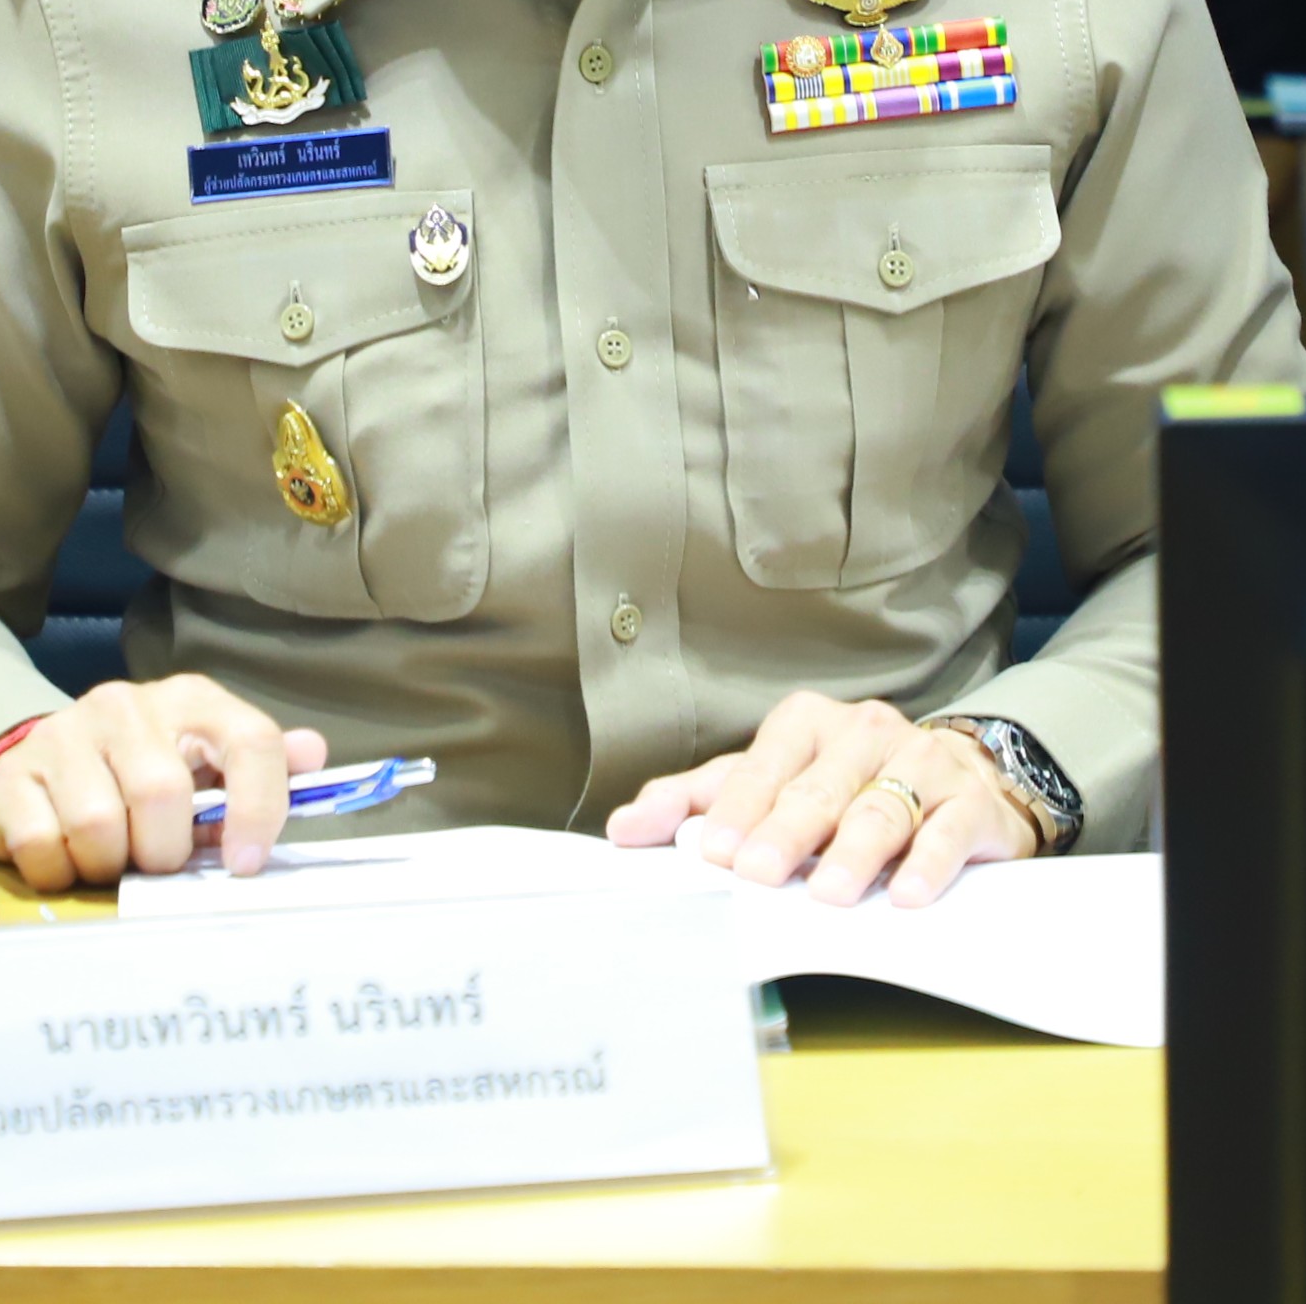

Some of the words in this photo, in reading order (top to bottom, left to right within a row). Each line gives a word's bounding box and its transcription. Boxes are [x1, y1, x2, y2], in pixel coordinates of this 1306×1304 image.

[238, 145, 286, 169] เทวินทร์
[297, 137, 341, 162] นรินทร์
[204, 159, 378, 194] ผู้ช่วยปลัดกระทรวงเกษตรและสหกรณ์
[40, 984, 309, 1053] นายเทวินทร์
[328, 972, 484, 1032] นรินทร์
